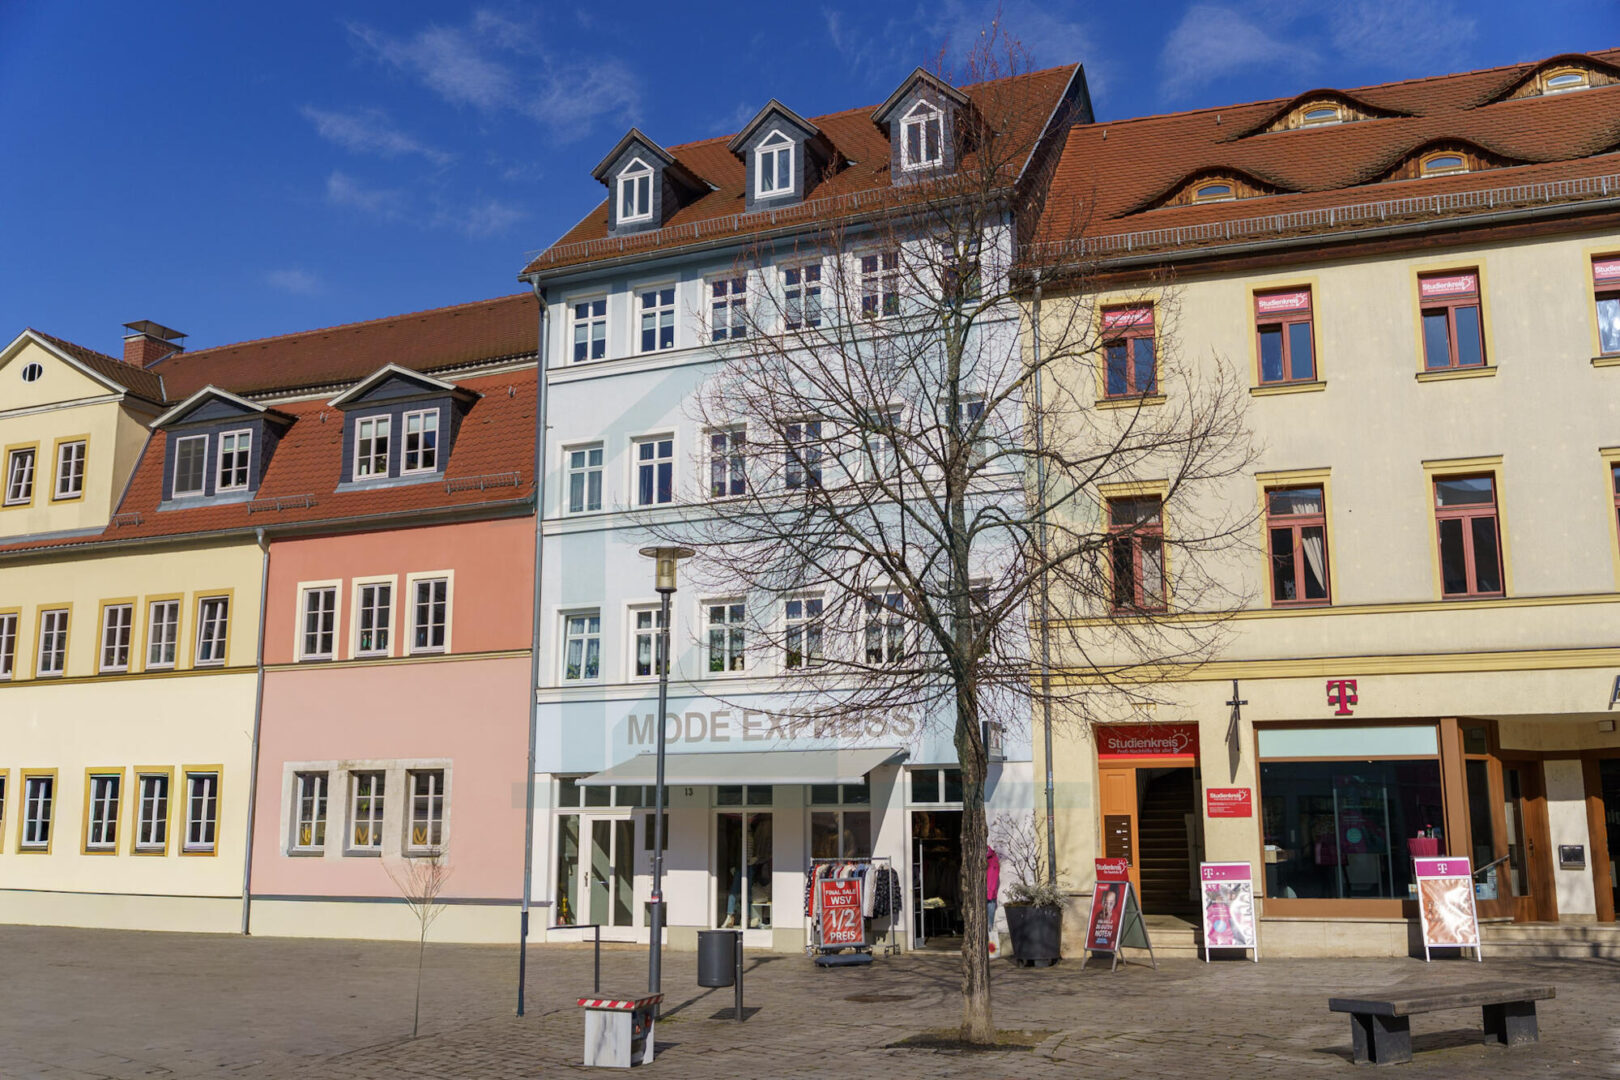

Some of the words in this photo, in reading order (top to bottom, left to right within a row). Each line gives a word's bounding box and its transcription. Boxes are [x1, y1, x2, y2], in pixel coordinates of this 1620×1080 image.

[1326, 679, 1358, 716] T
[627, 710, 731, 745] MODE
[742, 704, 916, 741] EXPRESS
[1108, 737, 1178, 749] Studienkreis
[685, 787, 693, 796] 13
[830, 895, 852, 905] WSV
[829, 908, 856, 931] 1/2
[830, 930, 856, 941] PREIS
